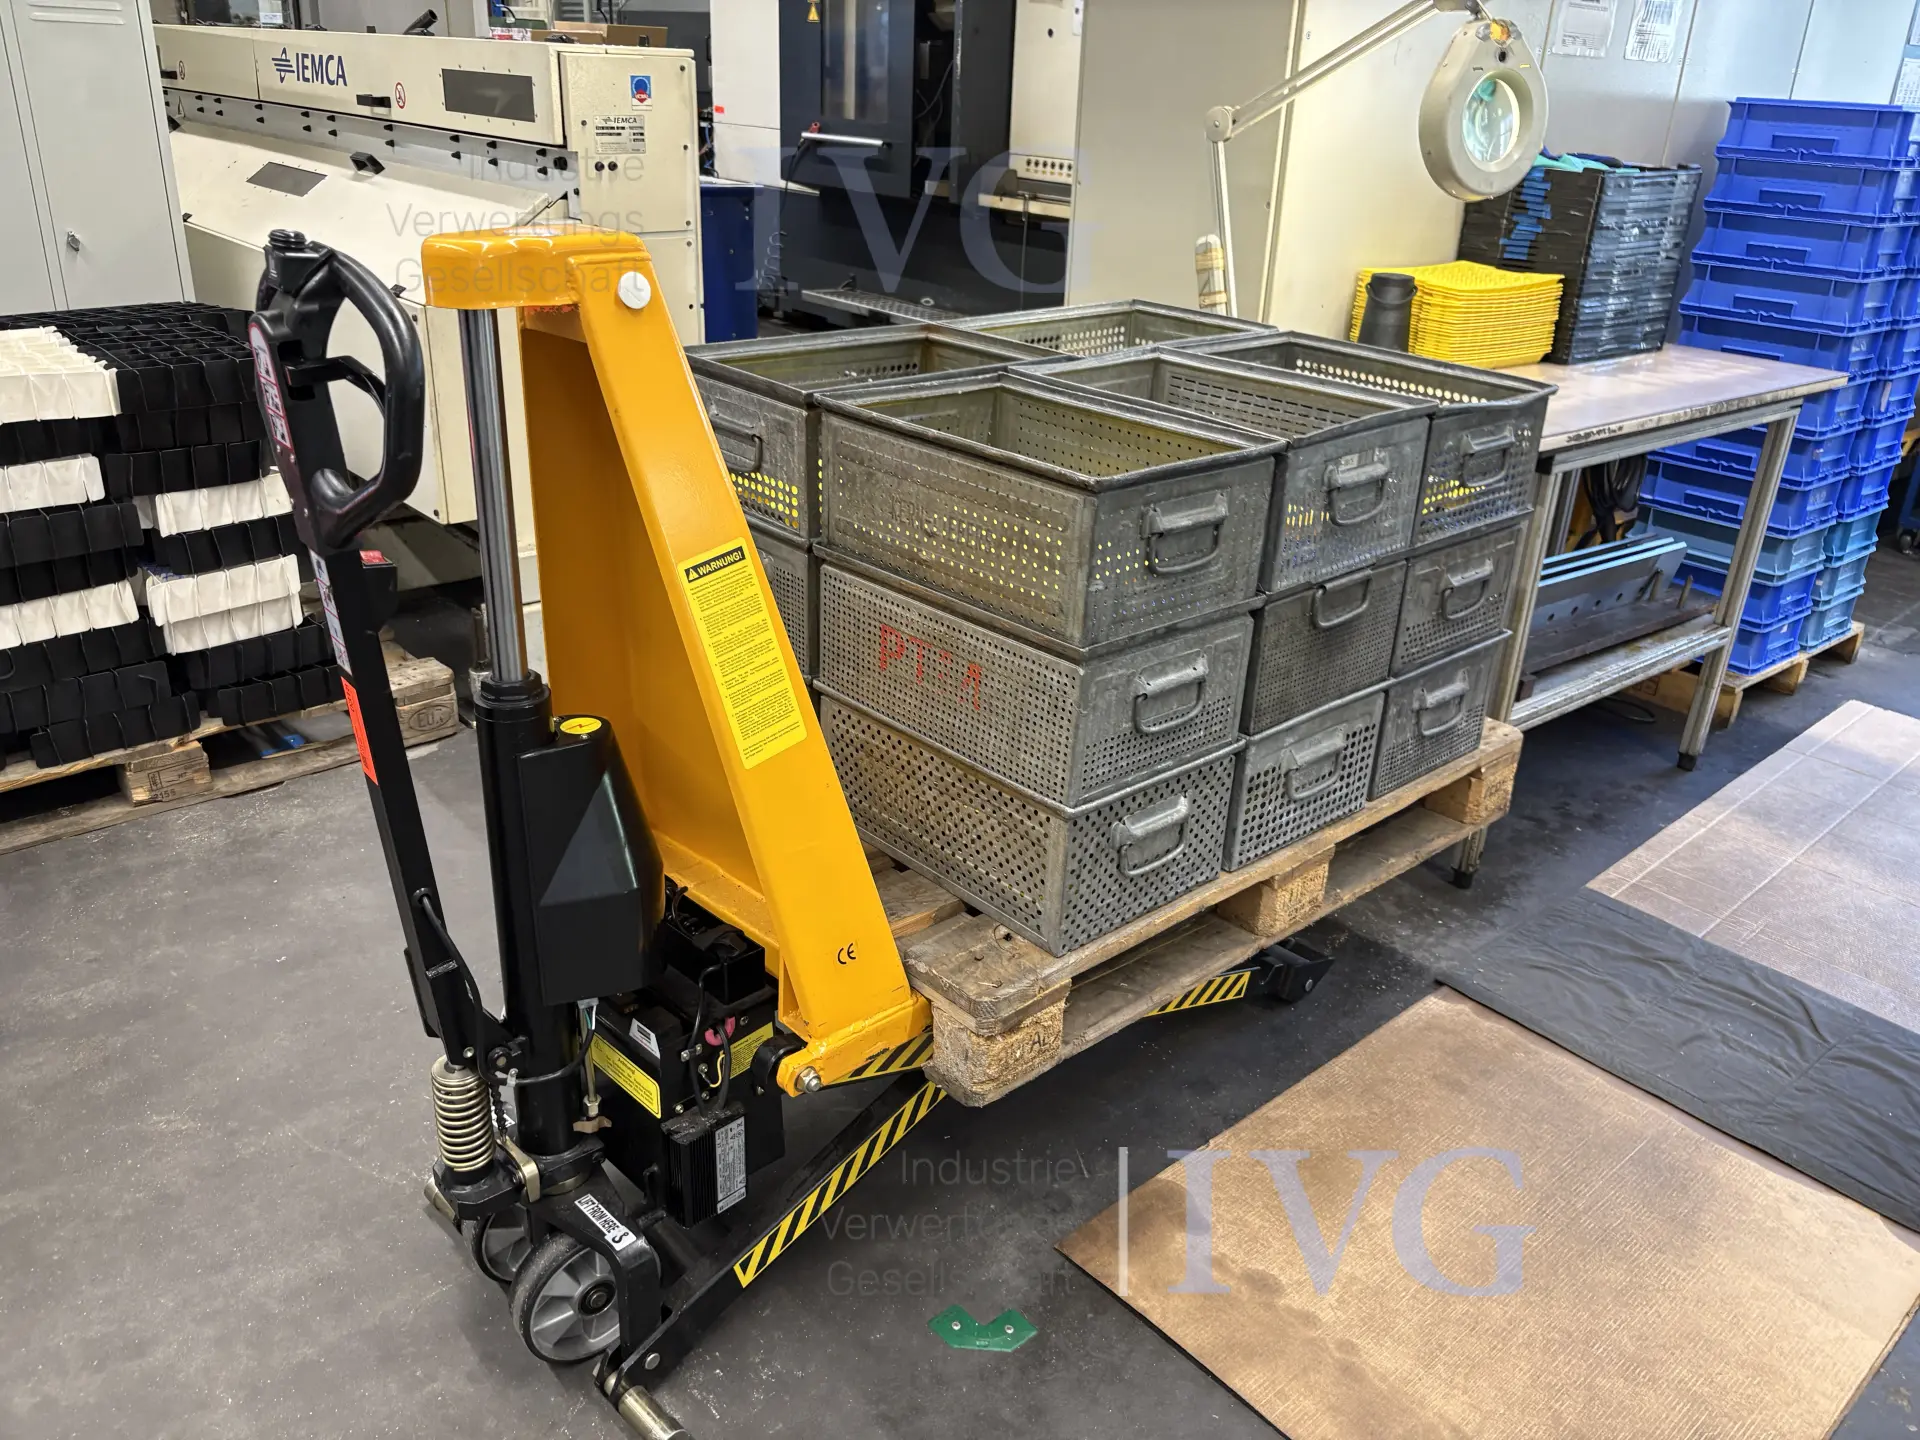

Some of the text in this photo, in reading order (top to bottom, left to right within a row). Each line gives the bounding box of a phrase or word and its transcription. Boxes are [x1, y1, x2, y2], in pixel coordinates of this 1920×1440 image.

[295, 52, 348, 87] IEMCA
[696, 550, 744, 577] WARNUNG!
[837, 942, 857, 965] CE
[577, 1195, 621, 1234] LIFT FROM HERE
